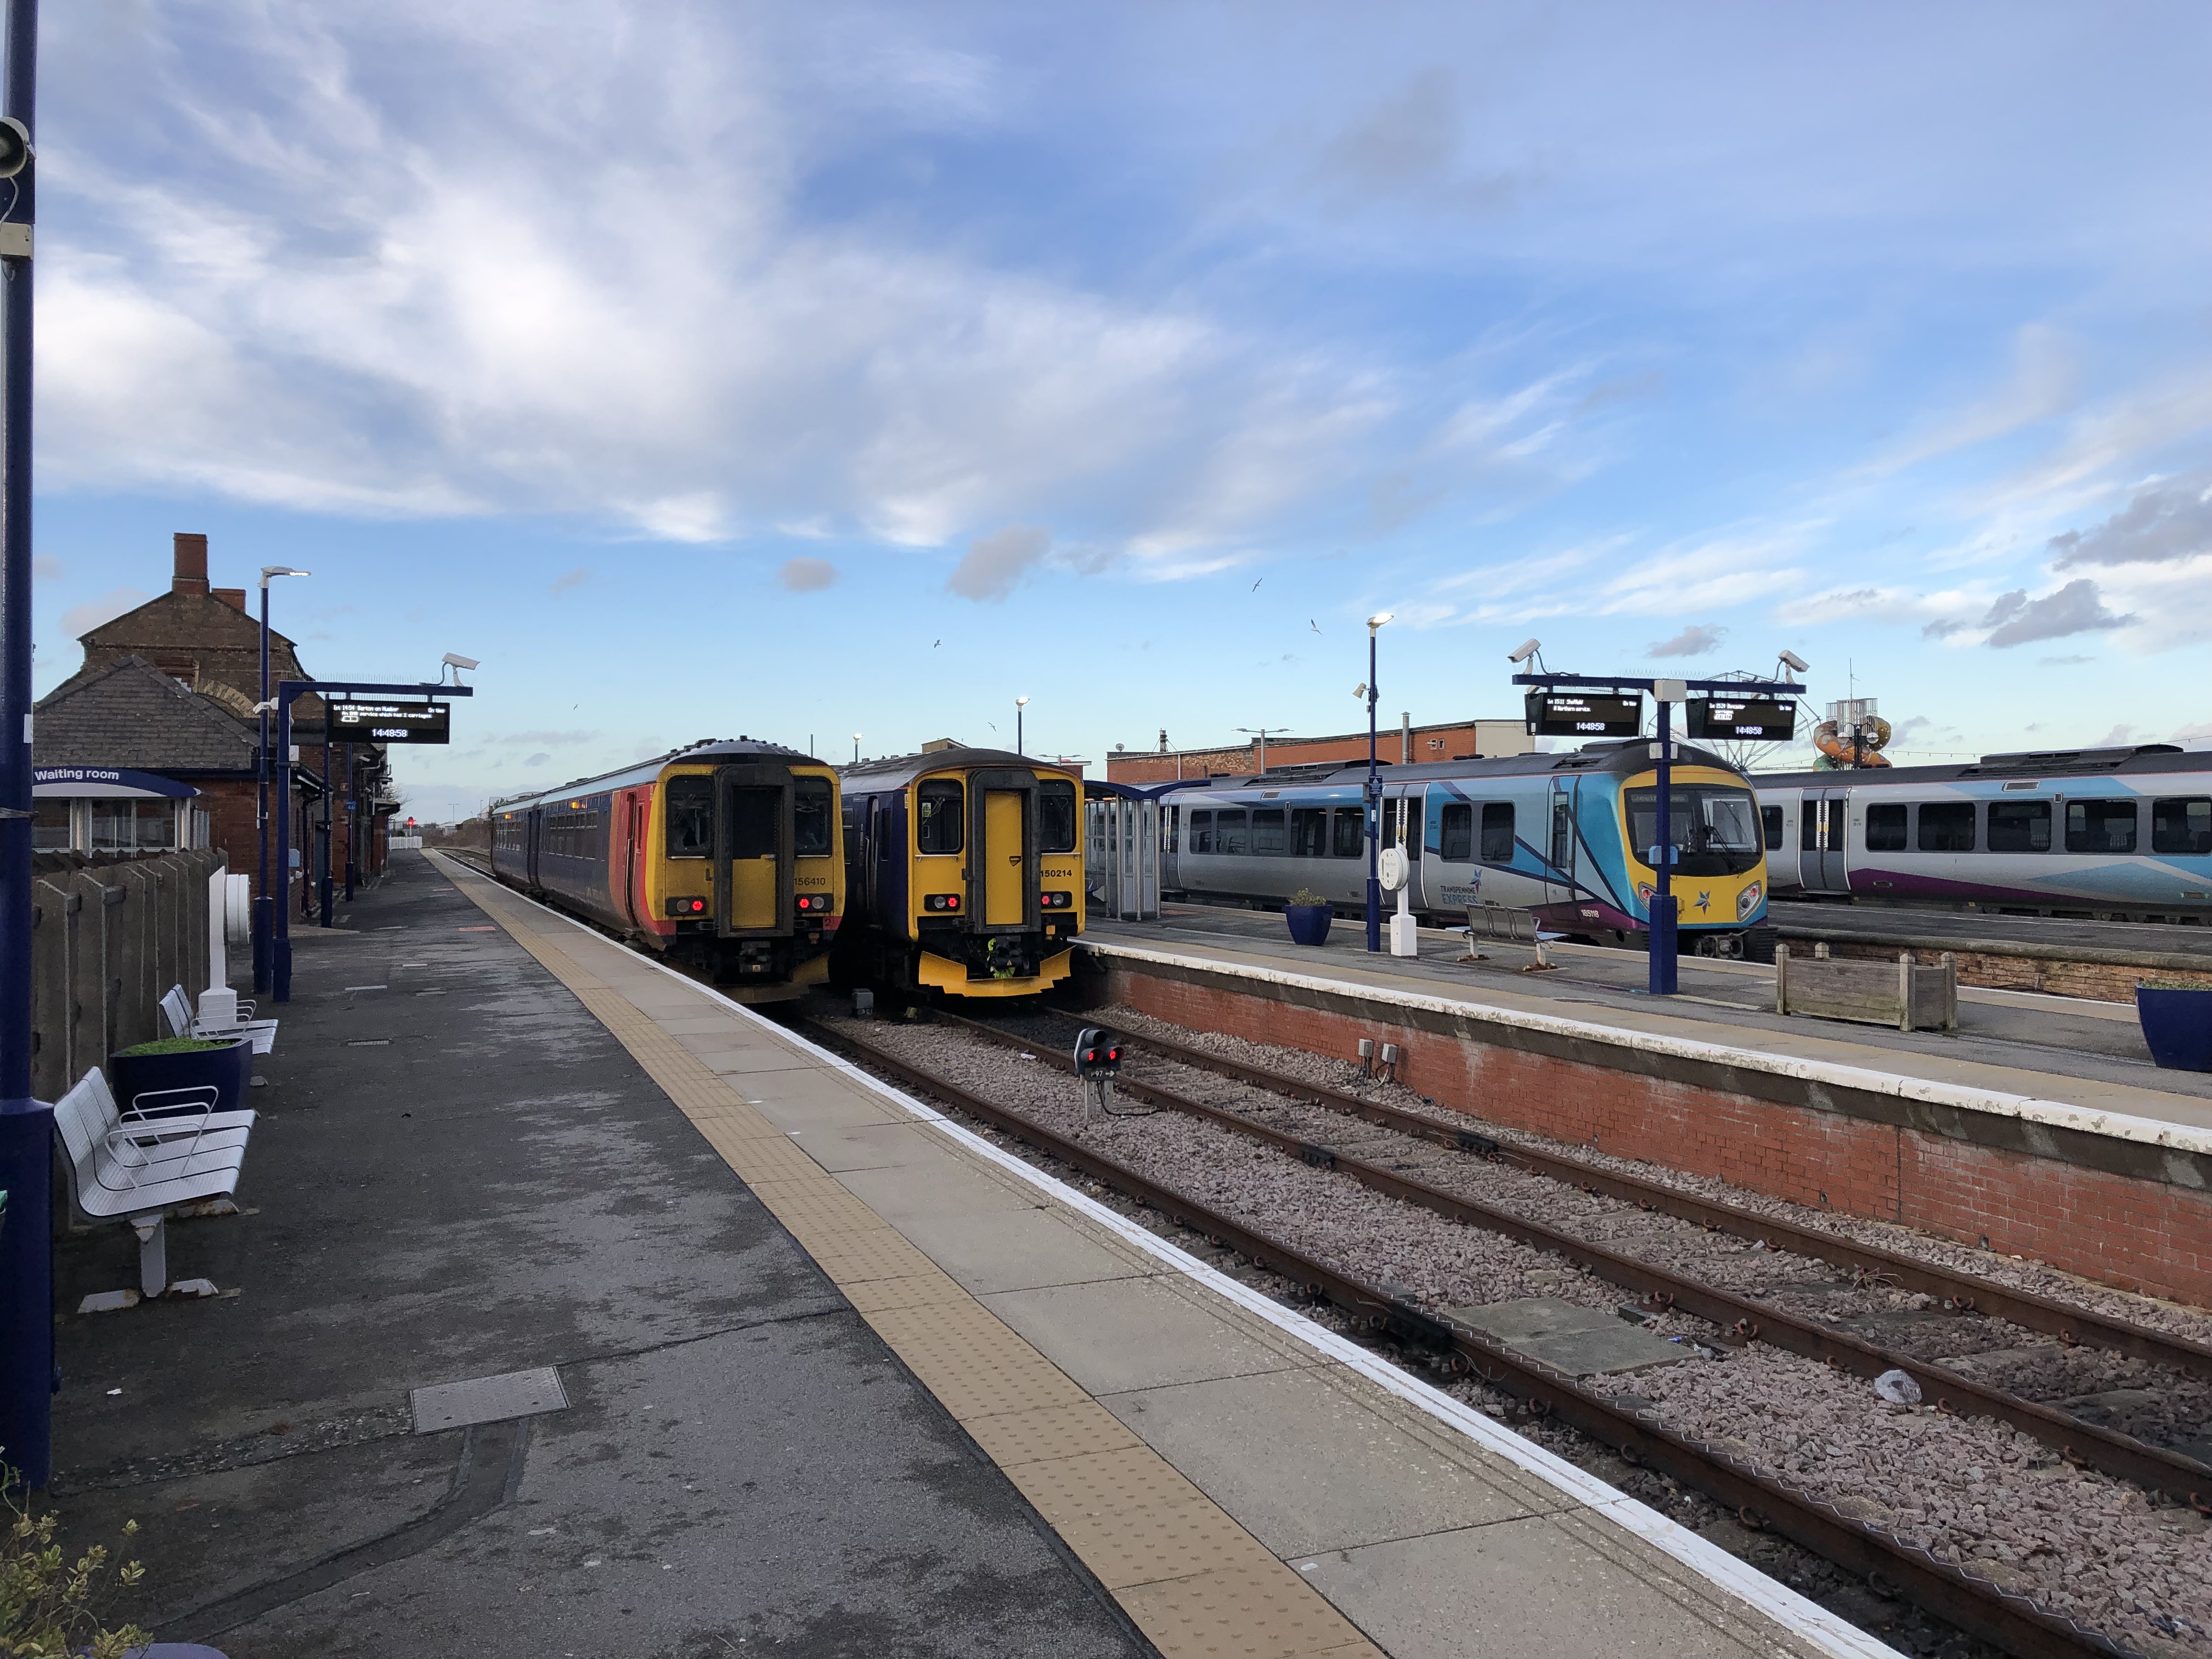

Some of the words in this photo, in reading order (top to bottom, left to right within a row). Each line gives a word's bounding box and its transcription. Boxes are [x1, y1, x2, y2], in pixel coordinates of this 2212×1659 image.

[1576, 722, 1605, 731] 14:48:58
[1735, 726, 1763, 735] 14:48:58
[371, 728, 408, 737] 14:48:58
[35, 769, 83, 780] Waiting
[86, 770, 119, 780] room
[1040, 869, 1072, 877] 150214
[794, 877, 826, 885] 156410
[1440, 885, 1476, 894] TRANSPENNINE
[1441, 894, 1479, 906] EXPRESS
[1581, 909, 1599, 918] 185118
